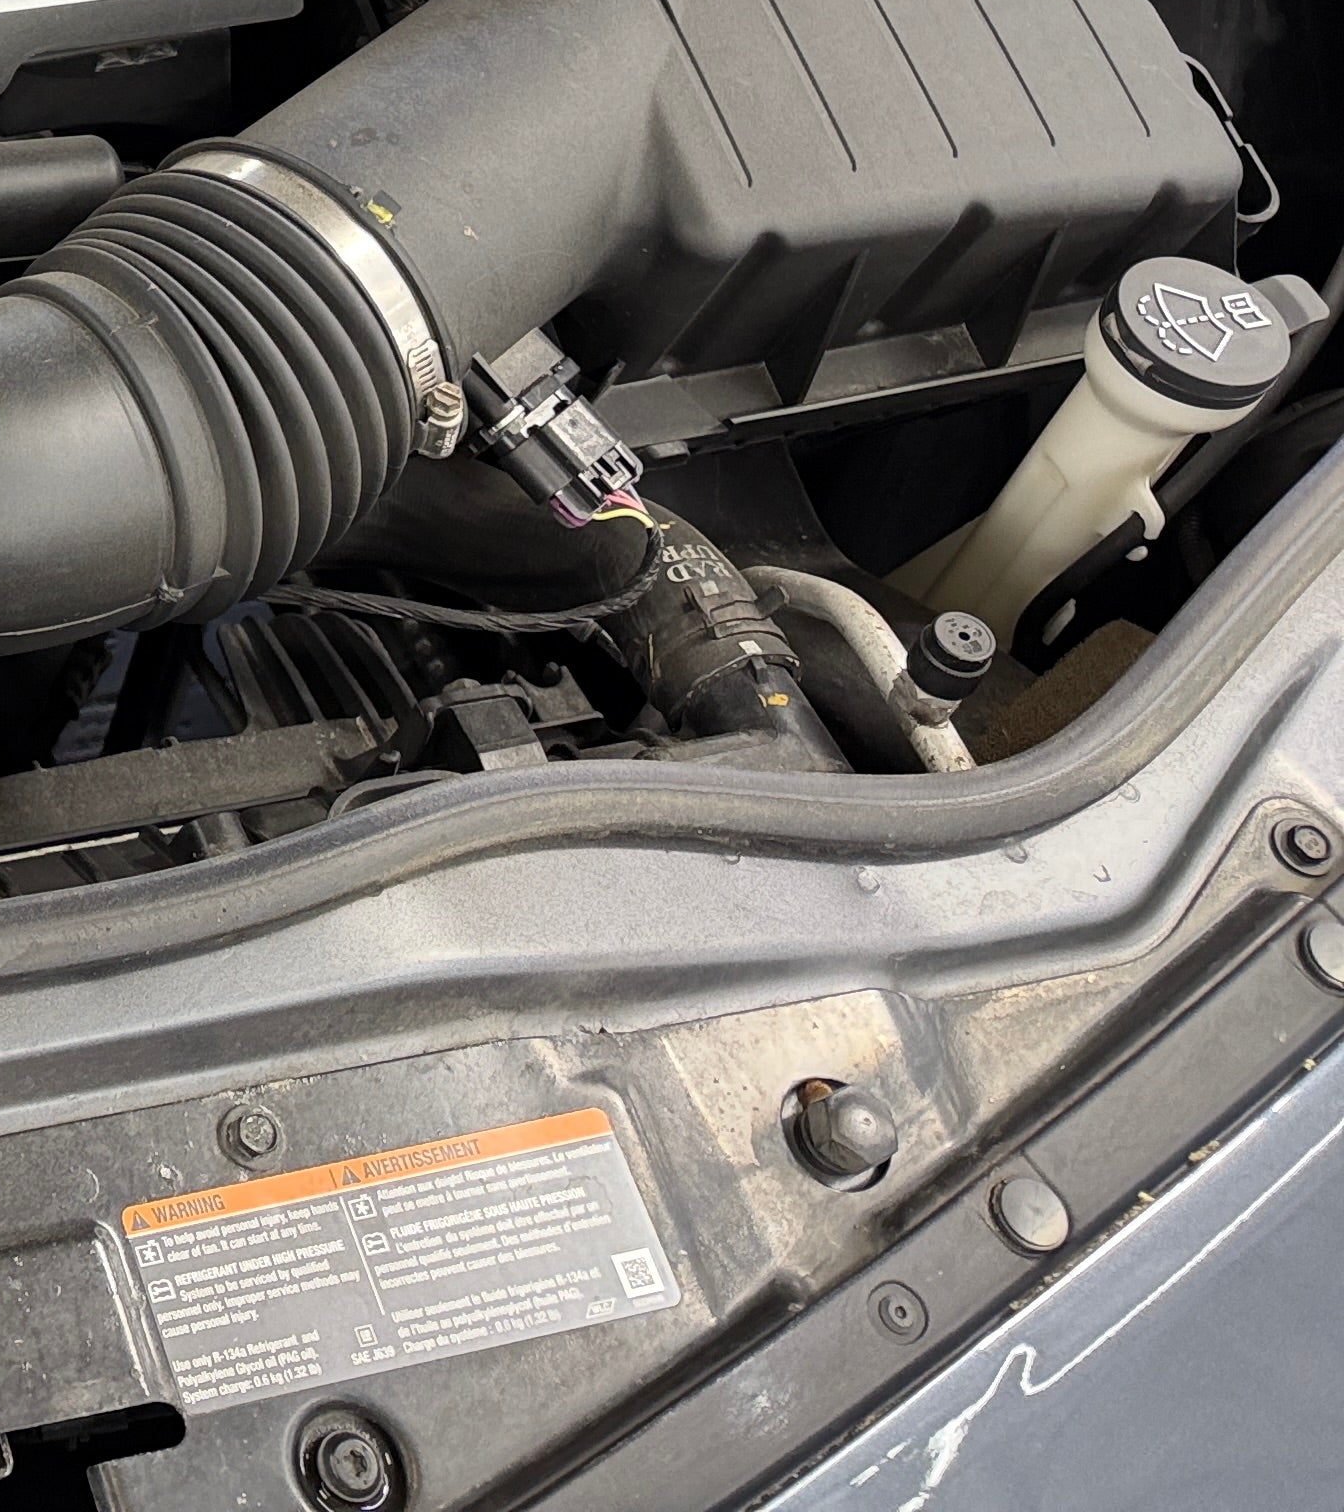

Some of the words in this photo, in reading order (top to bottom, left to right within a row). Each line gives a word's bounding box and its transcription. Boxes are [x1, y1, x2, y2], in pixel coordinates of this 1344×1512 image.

[665, 556, 732, 583] RAD
[361, 1140, 481, 1177] AVERTISSEMENT
[376, 1183, 416, 1200] Attention
[416, 1179, 434, 1191] aux
[464, 1166, 495, 1183] Risque
[495, 1164, 507, 1174] de
[552, 1151, 565, 1162] Le
[565, 1142, 611, 1160] ventilateur
[152, 1194, 224, 1222] WARNING
[381, 1202, 403, 1216] peut
[402, 1199, 414, 1209] se
[415, 1193, 445, 1207] mettre
[453, 1184, 485, 1199] tourner
[486, 1180, 507, 1192] sans
[390, 1222, 423, 1238] FLUIDE
[483, 1204, 509, 1217] SOUS
[509, 1197, 539, 1212] HAUTE
[539, 1187, 585, 1205] PRESSION
[162, 1235, 173, 1246] To
[174, 1231, 195, 1246] help
[194, 1226, 219, 1239] avoid
[220, 1217, 260, 1236] personal
[260, 1211, 287, 1228] injury,
[287, 1206, 311, 1222] keep
[310, 1200, 339, 1215] hands
[166, 1248, 190, 1261] clear
[191, 1246, 200, 1256] of
[202, 1242, 220, 1253] fan.
[220, 1240, 227, 1249] It
[228, 1236, 246, 1248] can
[246, 1231, 271, 1244] start
[271, 1229, 282, 1238] at
[282, 1225, 298, 1238] any
[298, 1221, 320, 1233] time.
[445, 1231, 458, 1242] du
[495, 1219, 514, 1231] doit
[569, 1204, 587, 1217] par
[586, 1201, 599, 1211] un
[174, 1263, 239, 1285] REFRIGERANT
[239, 1256, 271, 1272] UNDER
[272, 1250, 297, 1264] HIGH
[298, 1240, 345, 1259] PRESSURE
[374, 1256, 419, 1275] personnel
[418, 1248, 452, 1265] qualifié
[452, 1238, 501, 1256] seulement.
[501, 1234, 519, 1245] Des
[519, 1224, 563, 1241] méthodes
[379, 1270, 429, 1288] incorrectes
[429, 1262, 467, 1279] peuvent
[466, 1255, 496, 1269] causer
[497, 1251, 514, 1262] des
[514, 1241, 560, 1258] blessures.
[157, 1304, 202, 1324] personnel
[202, 1300, 224, 1314] only.
[225, 1291, 266, 1309] Improper
[267, 1283, 300, 1298] service
[300, 1274, 339, 1290] methods
[340, 1270, 361, 1284] may
[179, 1285, 215, 1302] System
[215, 1282, 225, 1292] to
[225, 1280, 237, 1290] be
[238, 1271, 277, 1287] serviced
[278, 1268, 290, 1281] by
[290, 1260, 330, 1278] qualified
[391, 1306, 424, 1322] Utiliser
[424, 1295, 471, 1315] seulement
[471, 1293, 481, 1304] le
[481, 1287, 507, 1302] fluide
[555, 1269, 589, 1285] R-134a
[588, 1267, 601, 1278] et
[162, 1324, 189, 1337] cause
[190, 1315, 230, 1333] personal
[231, 1309, 259, 1324] injury.
[397, 1325, 410, 1337] de
[403, 1336, 436, 1355] Charge
[435, 1333, 449, 1345] du
[510, 1316, 524, 1330] kg
[172, 1358, 191, 1371] Use
[191, 1353, 212, 1369] only
[212, 1346, 246, 1362] R-134a
[247, 1334, 298, 1356] Refrigerant
[300, 1330, 319, 1342] and
[177, 1365, 235, 1389] Polyalkylene
[235, 1359, 264, 1376] Glycol
[264, 1356, 277, 1367] oil
[277, 1351, 301, 1366] (PAG
[299, 1347, 319, 1361] oil).
[351, 1351, 370, 1364] SAE
[371, 1345, 395, 1359] J639
[182, 1385, 218, 1404] System
[218, 1377, 253, 1396] charge:
[269, 1371, 284, 1384] kg
